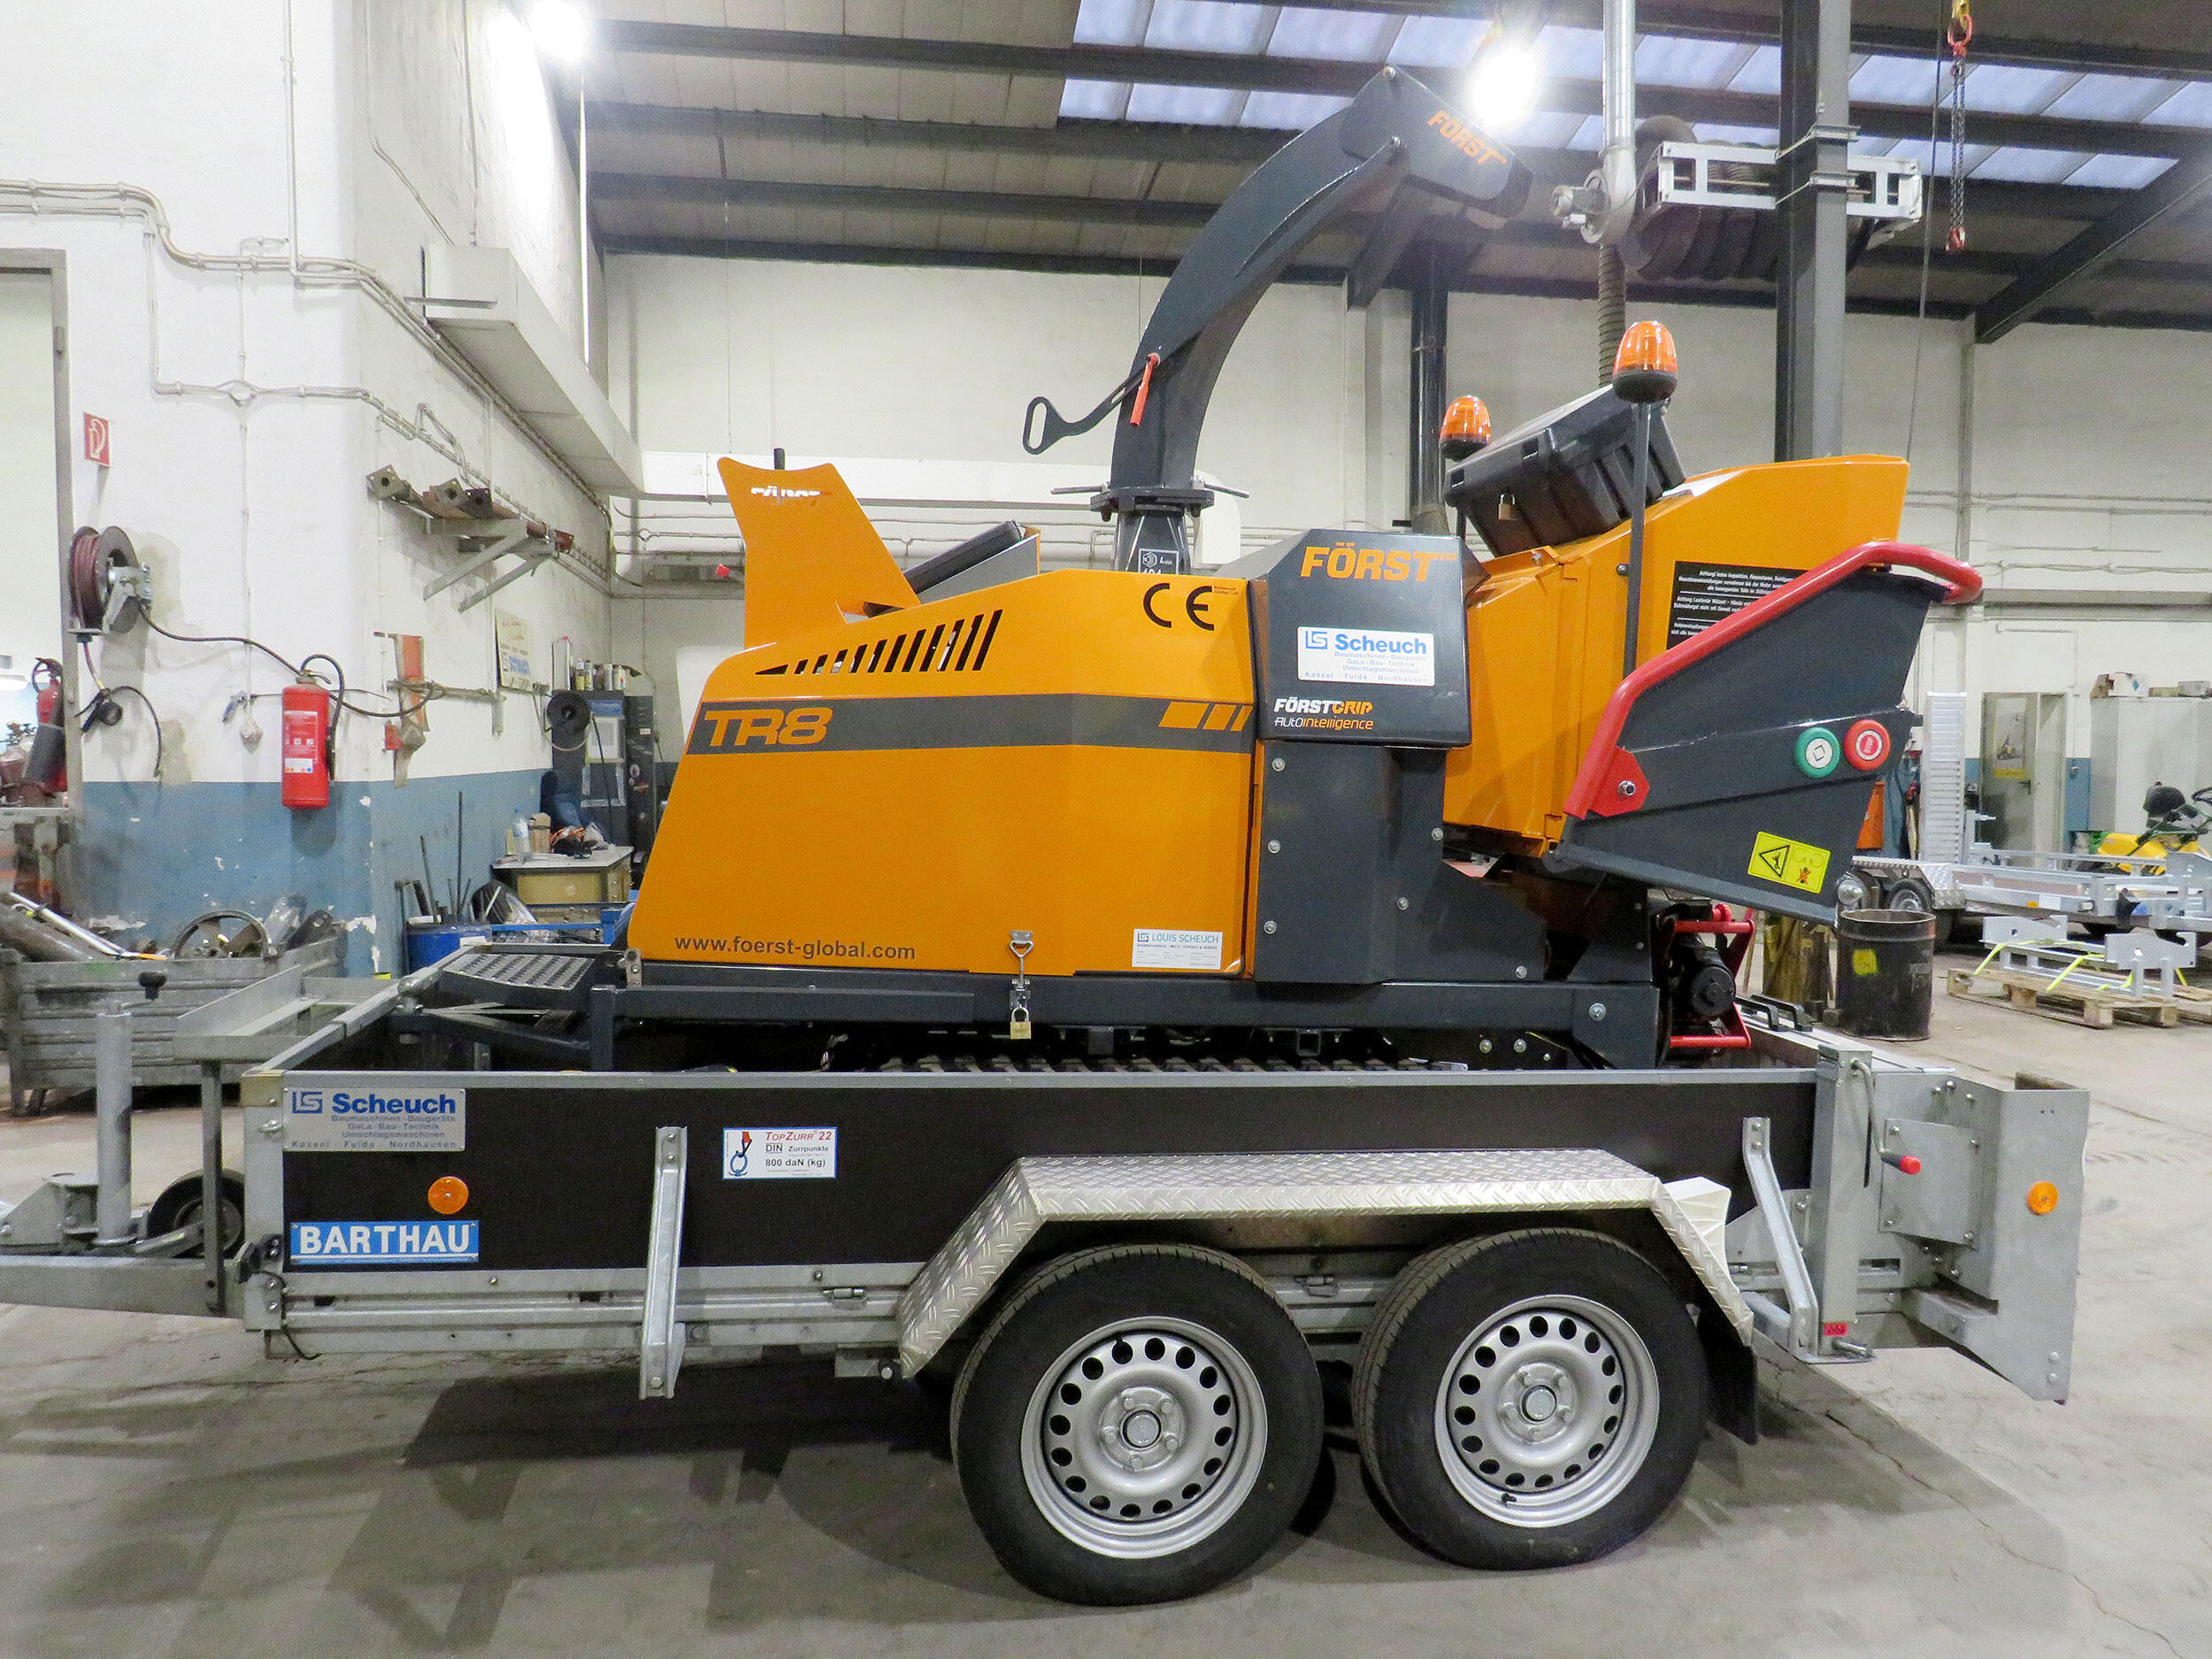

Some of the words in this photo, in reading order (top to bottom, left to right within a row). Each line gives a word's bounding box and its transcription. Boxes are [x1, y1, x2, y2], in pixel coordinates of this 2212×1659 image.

[1300, 541, 1456, 582] FÖRST
[1143, 582, 1215, 632] CE
[1335, 634, 1426, 655] Scheuch
[704, 707, 833, 747] TR8
[674, 935, 916, 960] www.foerst-global.com
[1152, 933, 1177, 942] LOUIS
[1179, 934, 1218, 943] SCHEUCH
[332, 1093, 456, 1114] Scheuch
[818, 1131, 832, 1141] 22
[807, 1159, 826, 1168] (kg)
[299, 1225, 470, 1254] BARTHAU
